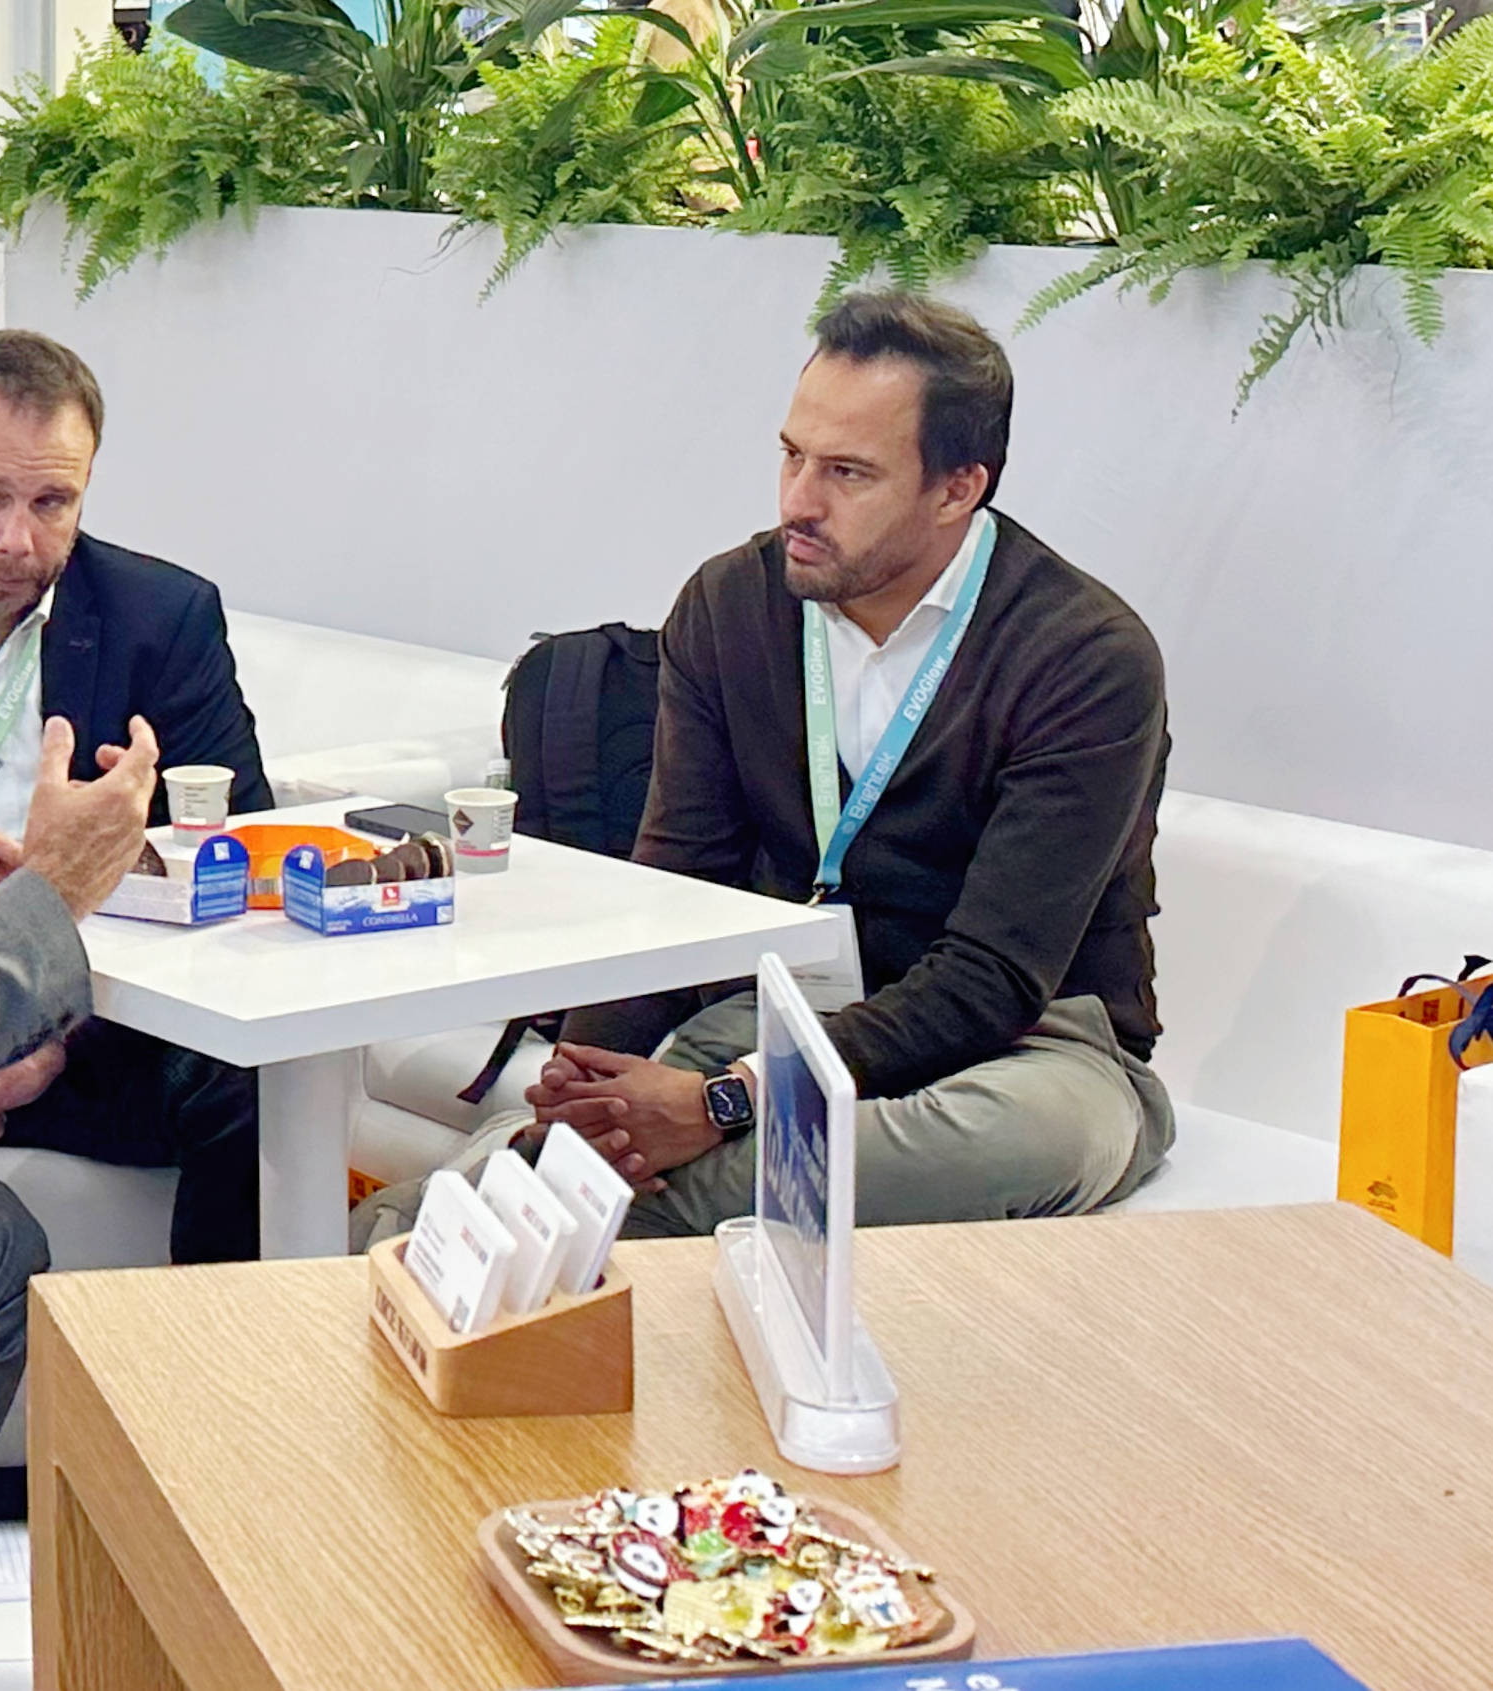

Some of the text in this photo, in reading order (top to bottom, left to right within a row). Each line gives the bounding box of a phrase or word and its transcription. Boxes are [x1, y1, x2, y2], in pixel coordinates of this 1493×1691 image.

[810, 637, 827, 705] EVOGlow
[903, 655, 946, 722] EVOGlow
[849, 752, 895, 820] Brightek
